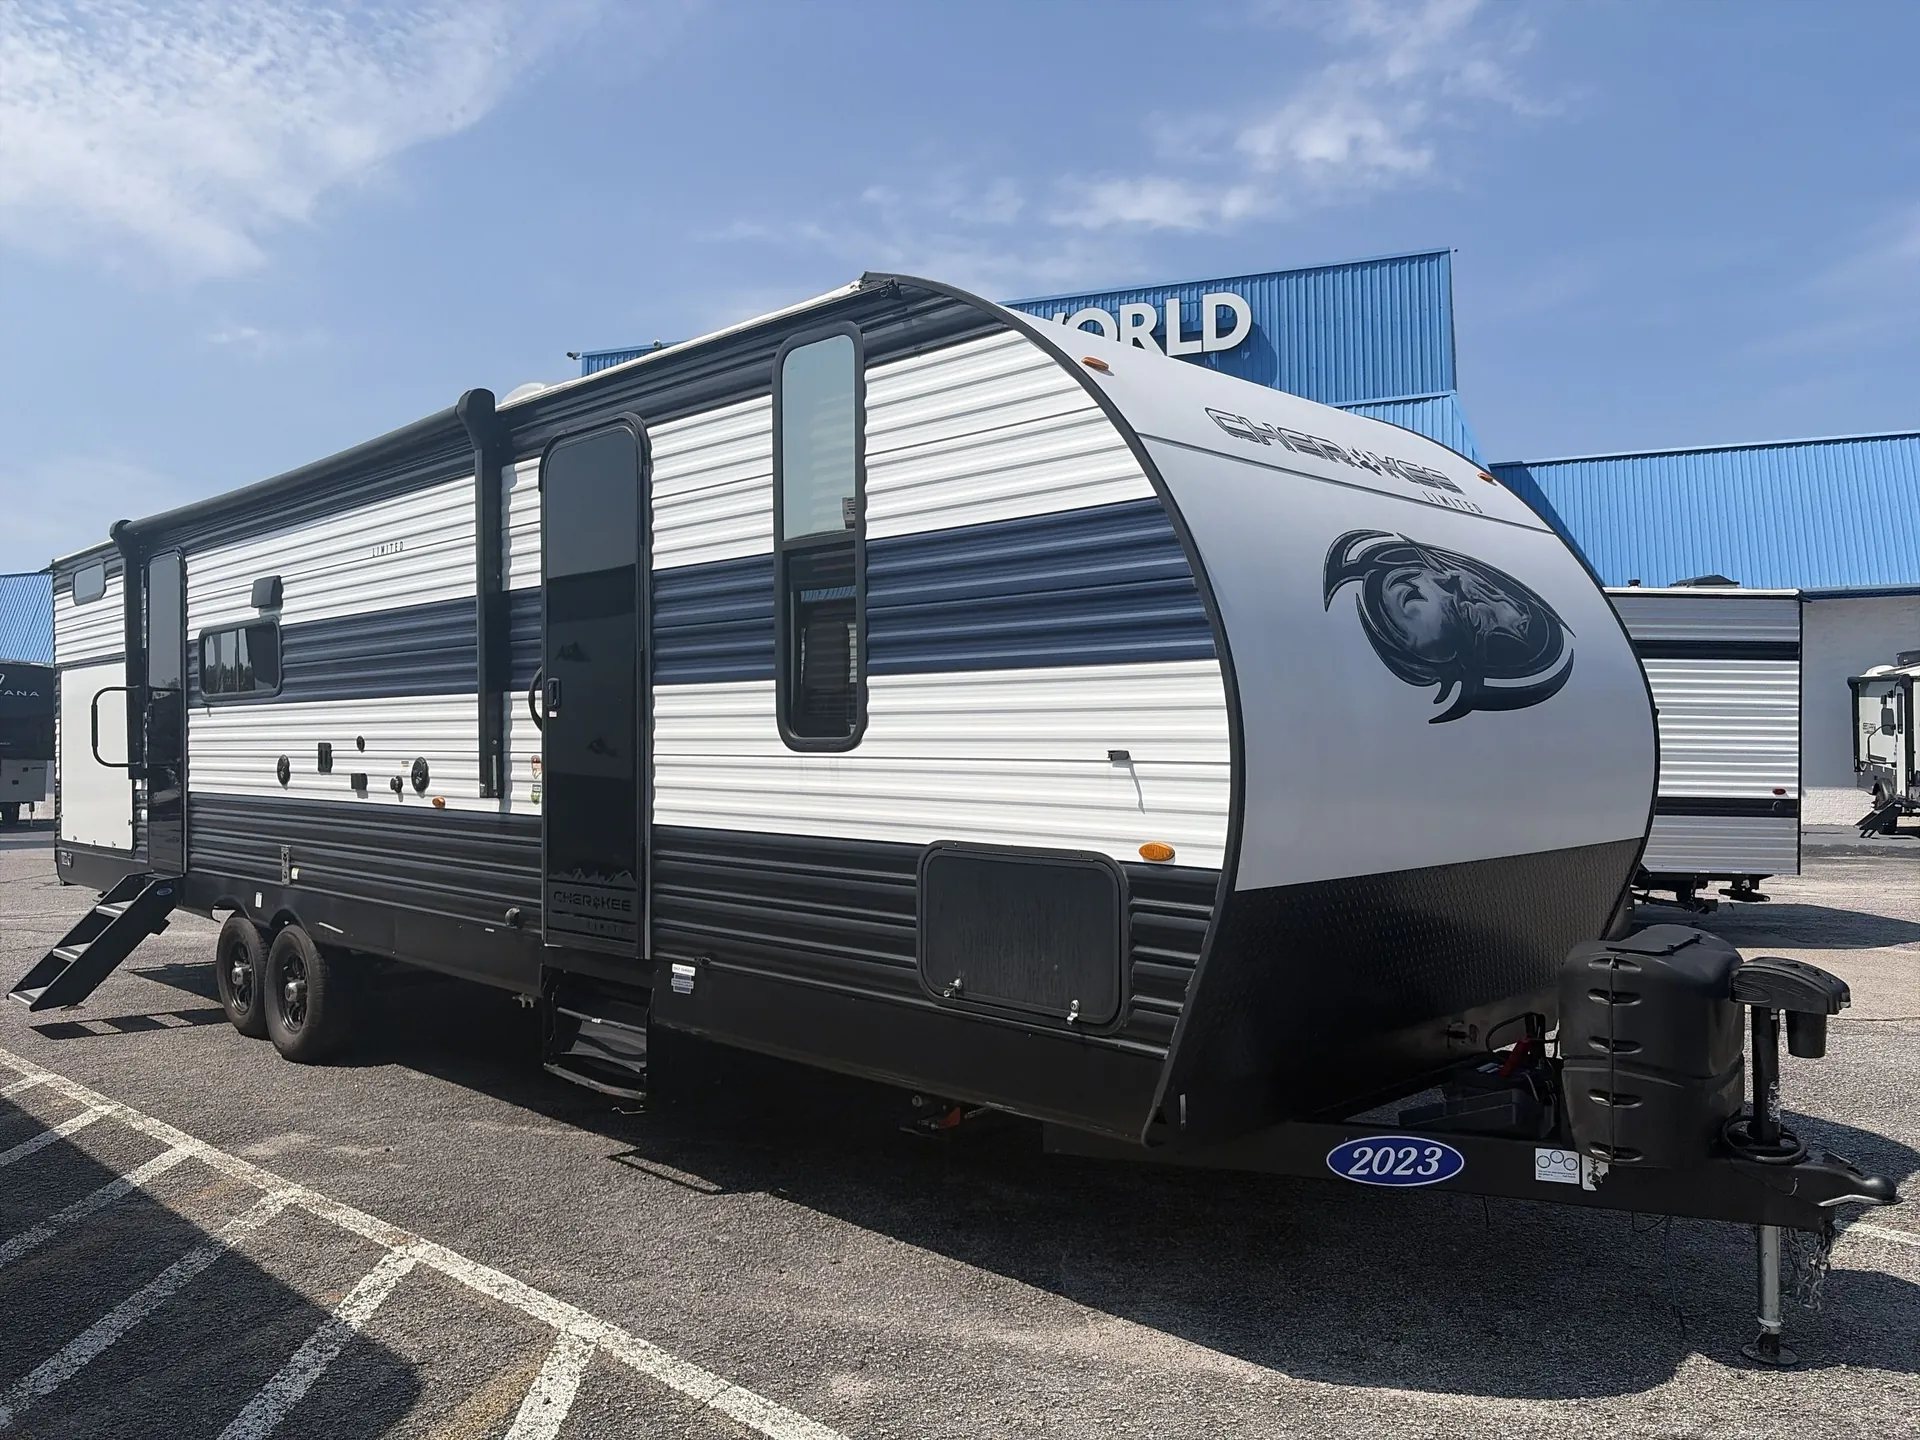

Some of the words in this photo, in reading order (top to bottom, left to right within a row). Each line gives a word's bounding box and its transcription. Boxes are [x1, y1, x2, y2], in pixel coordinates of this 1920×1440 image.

[1053, 292, 1252, 356] ORLD
[1204, 407, 1466, 495] CHEROKEE
[1421, 490, 1483, 514] LIMITED
[372, 541, 404, 558] LIMITED
[553, 891, 633, 912] CHEROKEE
[1347, 1146, 1444, 1176] 2023
